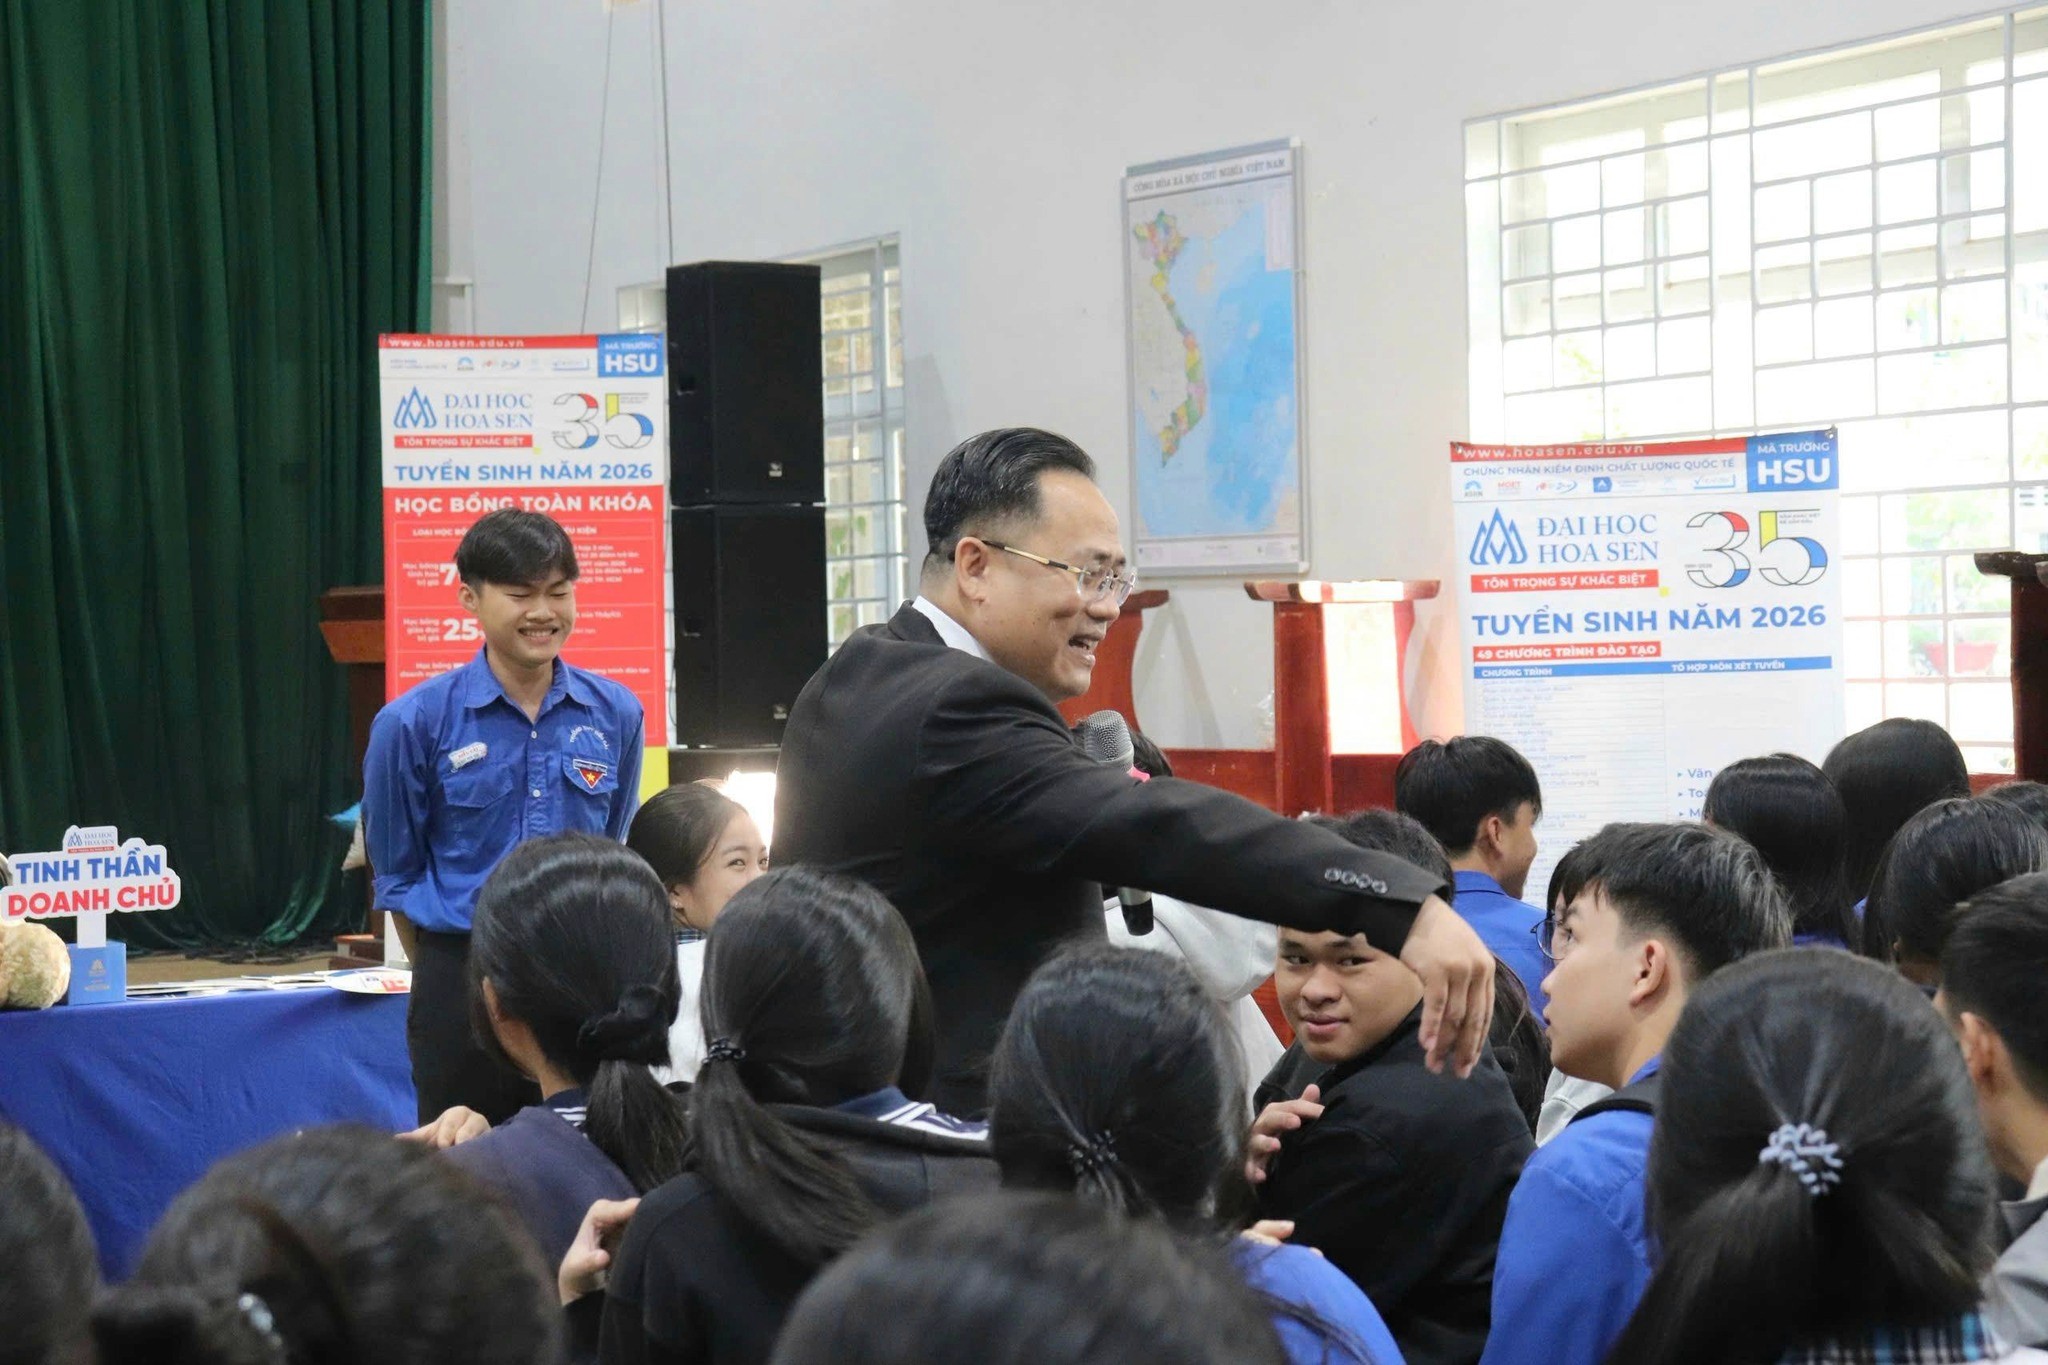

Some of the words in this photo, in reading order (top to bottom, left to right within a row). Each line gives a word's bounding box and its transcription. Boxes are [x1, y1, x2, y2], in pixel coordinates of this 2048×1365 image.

[389, 338, 524, 348] www.hoasen.edu.vn
[604, 353, 658, 373] HSU
[445, 413, 490, 429] HOA
[494, 413, 533, 429] SEN
[1463, 444, 1644, 459] www.hoasen.edu.vn
[1757, 443, 1776, 454] MÃ
[1779, 441, 1830, 453] TRƯỜNG
[394, 459, 470, 481] TUYỂN
[478, 464, 532, 481] SINH
[540, 460, 592, 480] NĂM
[600, 463, 653, 480] 2026
[1757, 457, 1831, 485] HSU
[394, 496, 442, 516] HỌC
[519, 492, 582, 512] TOÀN
[589, 492, 653, 512] KHÓA
[1539, 542, 1600, 564] HOA
[1606, 541, 1660, 562] SEN
[439, 562, 460, 586] 7
[1482, 577, 1509, 588] TÔN
[1513, 576, 1557, 589] TRỌNG
[1560, 574, 1578, 587] SỰ
[1581, 572, 1615, 585] KHÁC
[1619, 572, 1647, 587] BIỆT
[1472, 604, 1574, 636] TUYỂN
[1584, 610, 1657, 633] SINH
[1669, 603, 1741, 631] NĂM
[1750, 604, 1827, 628] 2026
[1496, 647, 1552, 660] CHƯƠNG
[1555, 643, 1594, 658] TRÌNH
[1598, 642, 1627, 656] ĐÀO
[1630, 644, 1657, 658] TẠO
[1687, 767, 1713, 778] Văn
[15, 859, 80, 884] TINH
[87, 846, 162, 880] THẦN
[8, 888, 110, 917] DOANH
[117, 876, 175, 908] CHỦ
